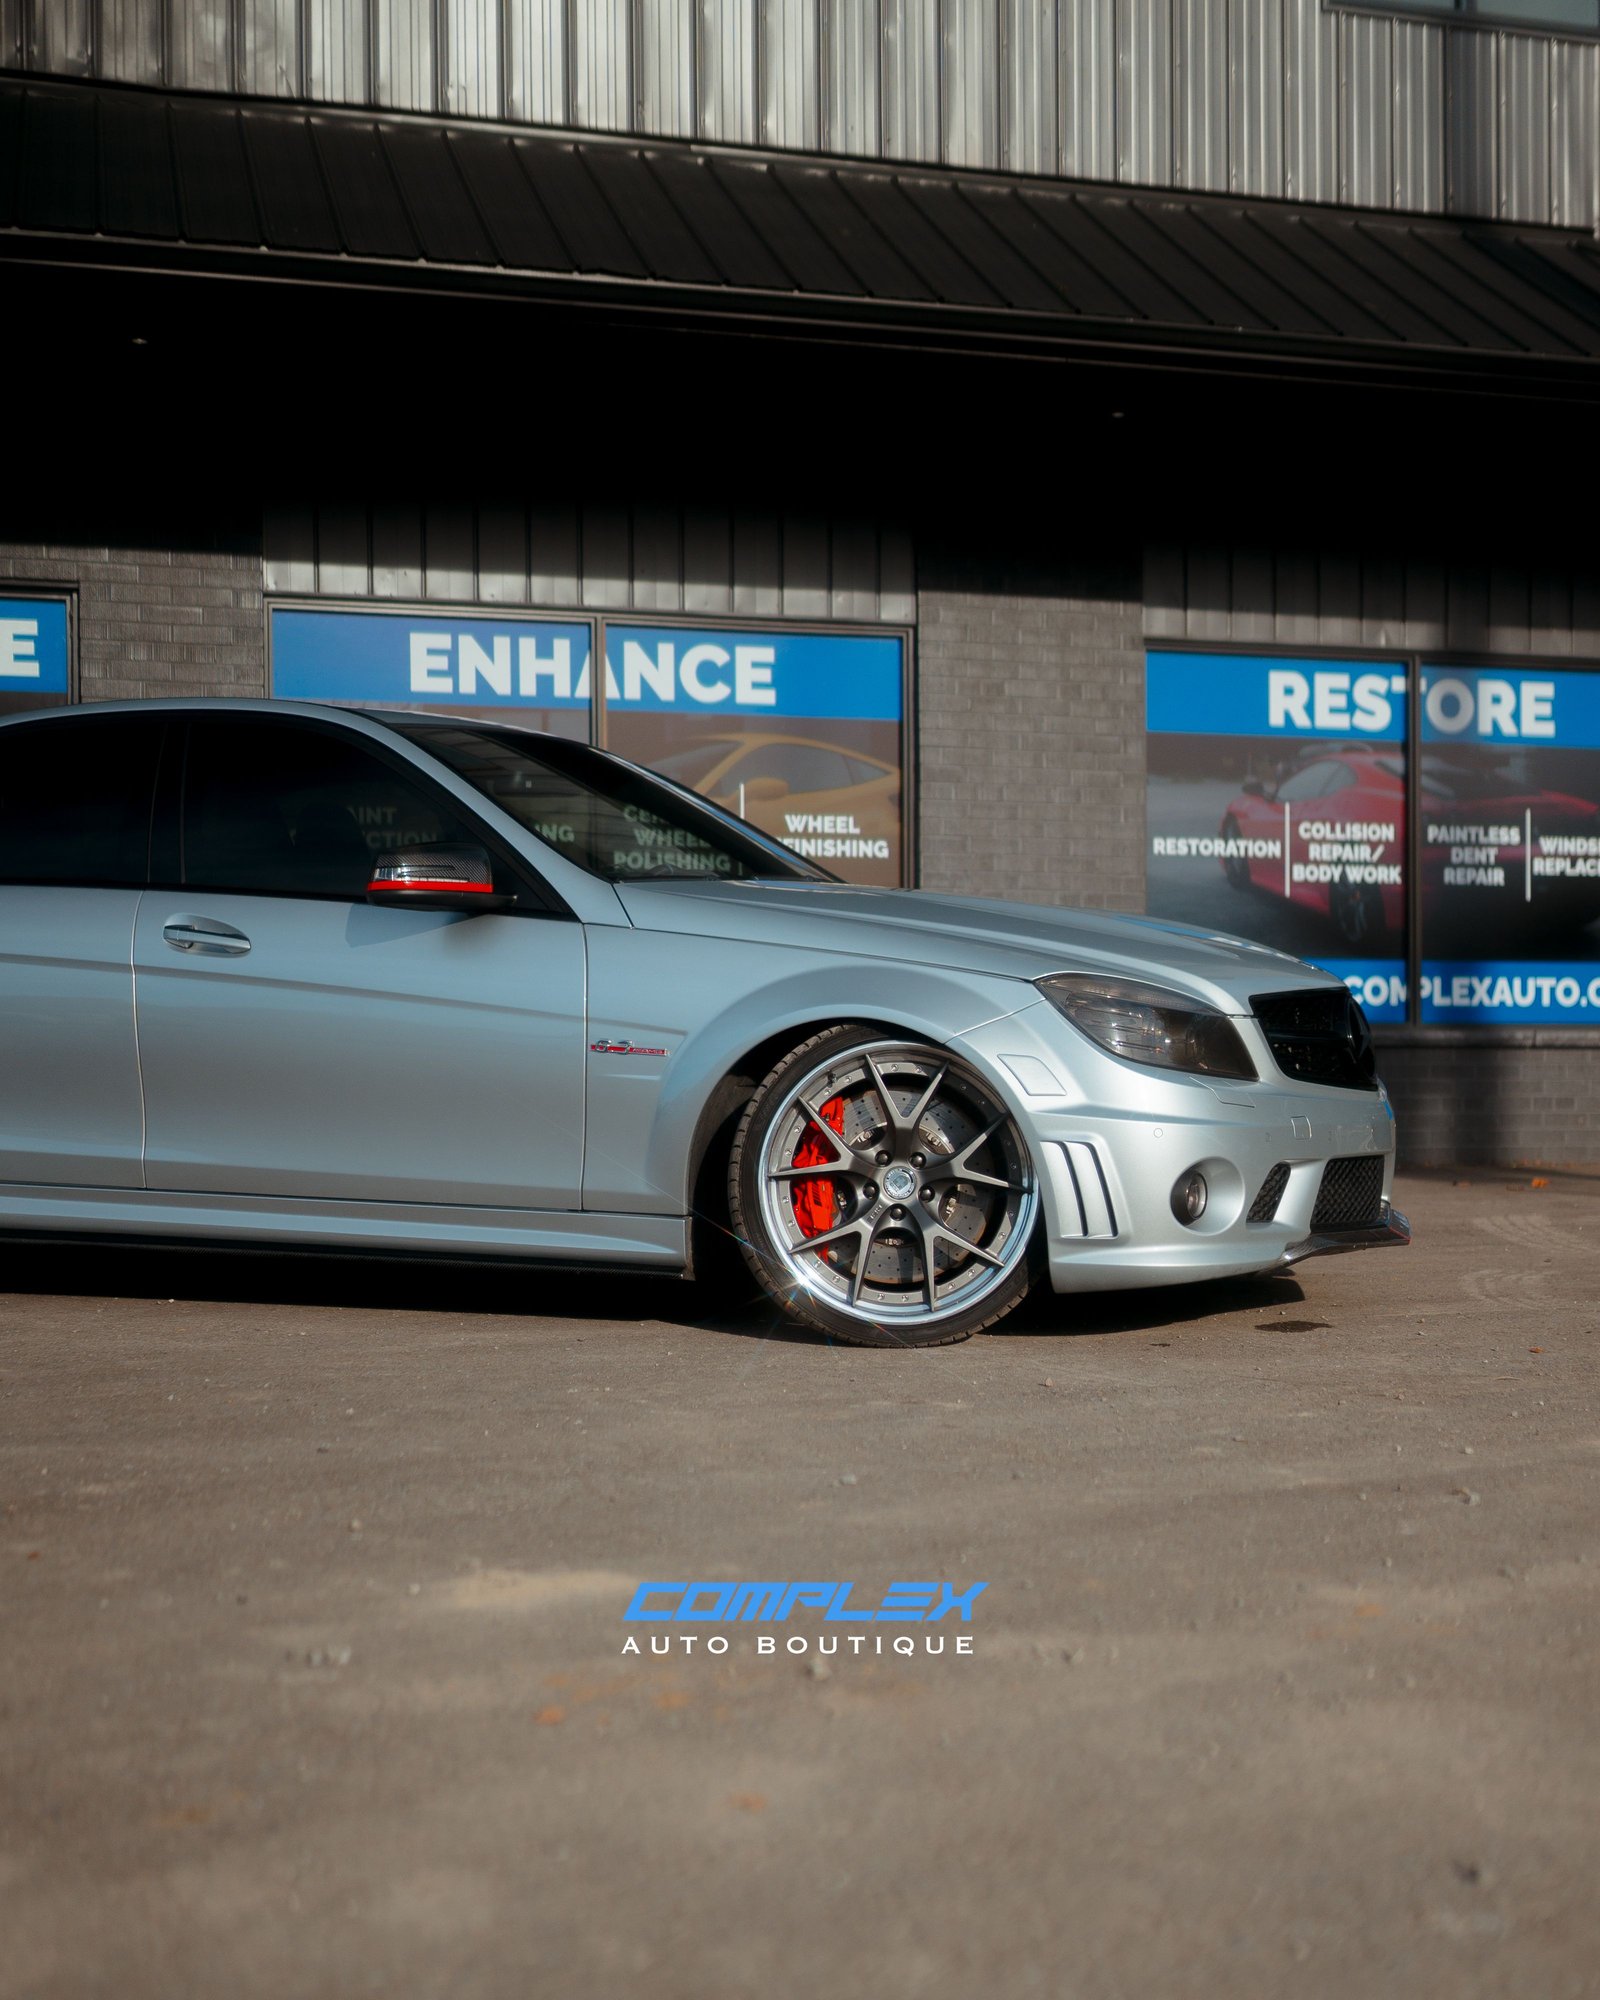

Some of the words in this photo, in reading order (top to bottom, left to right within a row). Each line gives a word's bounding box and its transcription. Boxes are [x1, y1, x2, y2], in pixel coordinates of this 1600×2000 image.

[1268, 669, 1556, 737] RESORE
[784, 814, 860, 834] WHEEL
[1298, 821, 1395, 842] COLLISION
[1427, 825, 1521, 846] PAINTLESS
[776, 837, 889, 858] FINISHING
[1152, 837, 1281, 858] RESTORATION
[1308, 843, 1385, 863] REPAIR/
[1450, 846, 1499, 865] DENT
[1539, 836, 1600, 857] WINDS
[1292, 864, 1344, 883] BODY
[1345, 864, 1402, 884] WORK
[1444, 867, 1505, 887] REPAIR
[1532, 857, 1600, 878] REPLAC
